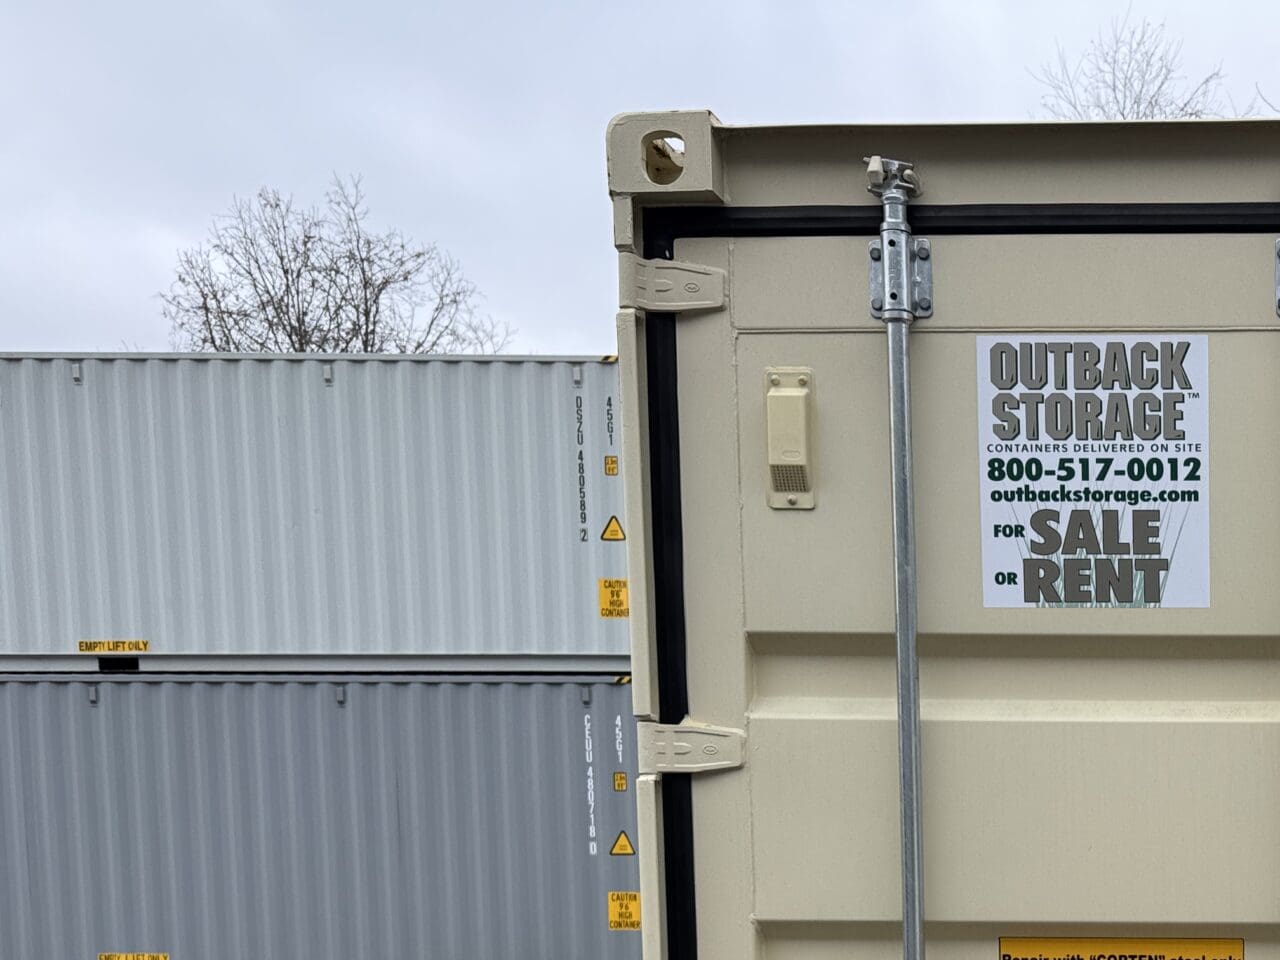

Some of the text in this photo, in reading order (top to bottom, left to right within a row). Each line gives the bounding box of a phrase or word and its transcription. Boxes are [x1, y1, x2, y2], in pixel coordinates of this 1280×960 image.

[990, 341, 1192, 391] OUTBACK
[992, 392, 1186, 441] STORAGE
[987, 443, 1202, 453] CONTAINERS DELIVERED ON SITE
[987, 457, 1202, 482] 800-517-0012
[990, 484, 1199, 505] outbackstorage.com
[993, 508, 1161, 555] FOR SALE
[994, 558, 1169, 603] OR RENT
